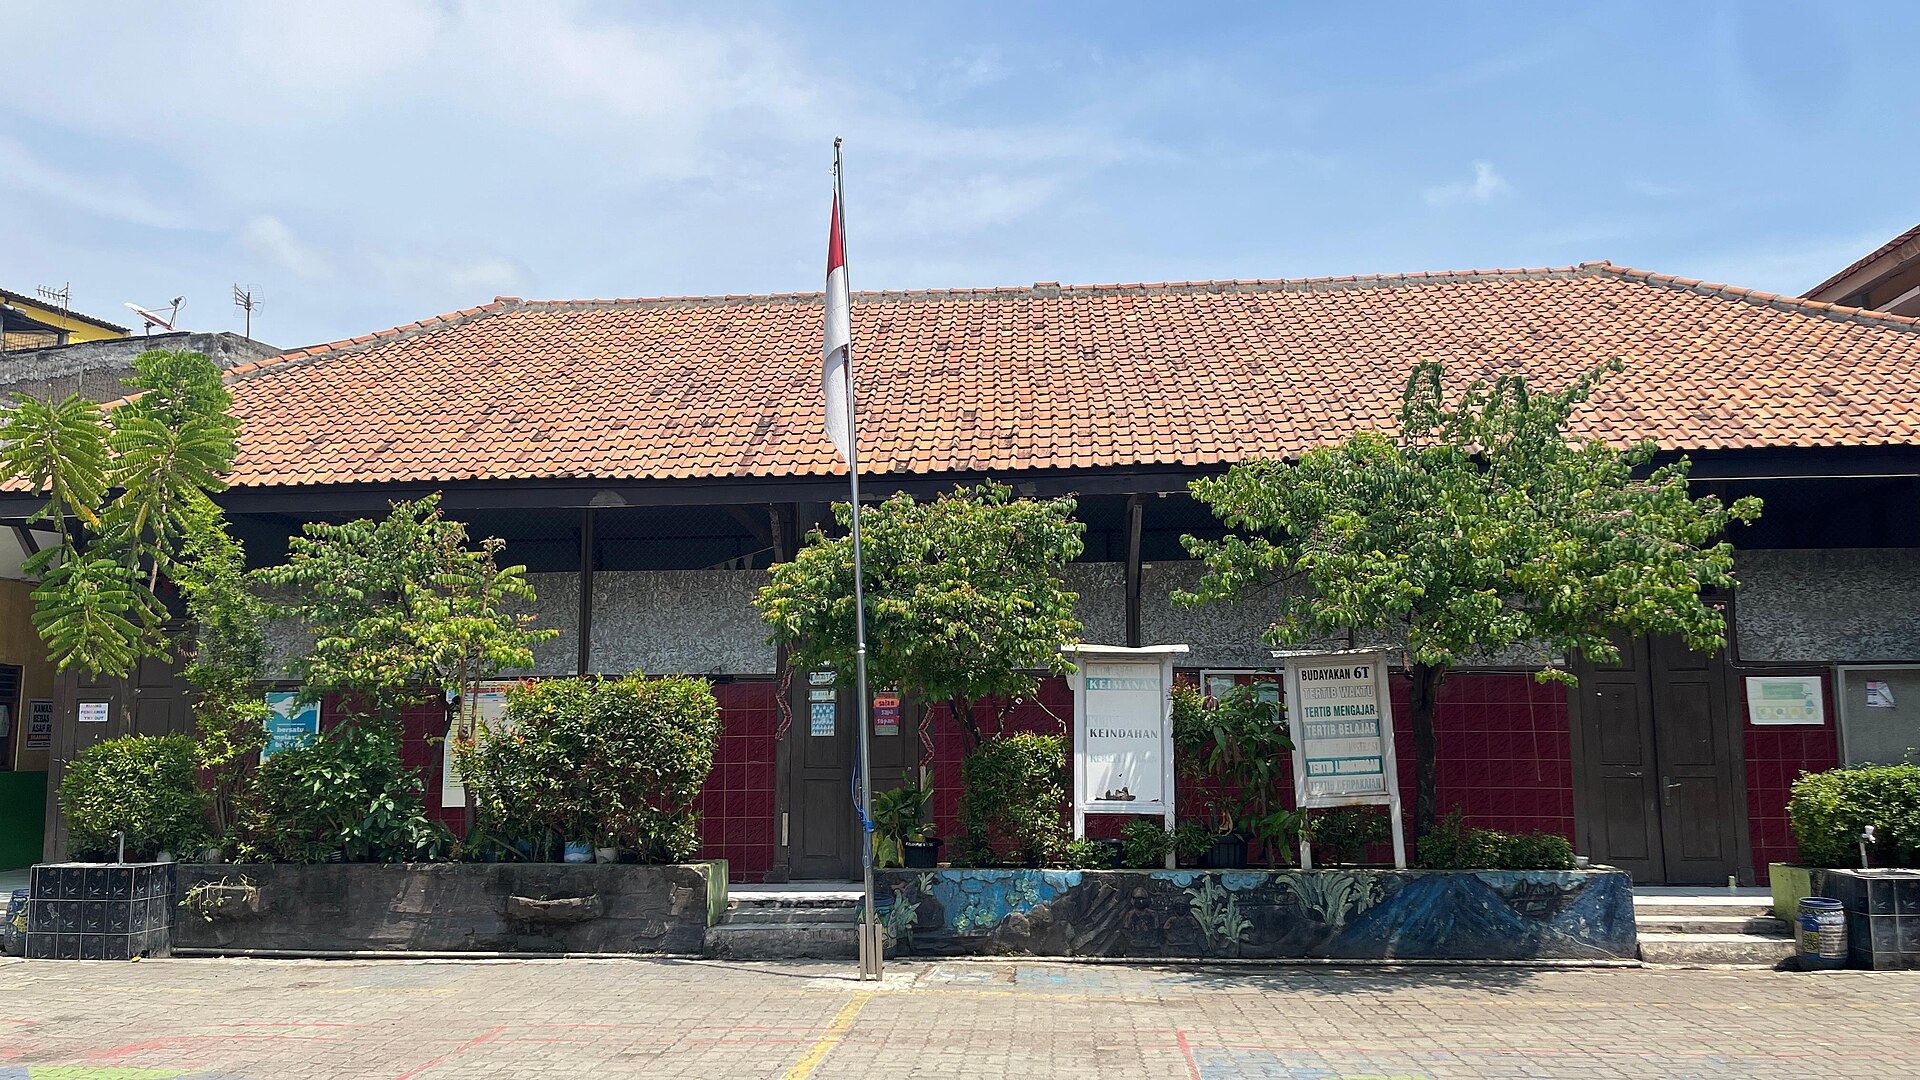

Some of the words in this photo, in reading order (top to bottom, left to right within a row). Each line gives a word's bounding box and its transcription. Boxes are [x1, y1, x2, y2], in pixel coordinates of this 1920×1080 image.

[1301, 668, 1351, 681] BUDAYAKAN
[1353, 666, 1370, 679] 6T
[1303, 686, 1338, 699] TERTIB
[1339, 685, 1374, 698] WAKTU
[1304, 706, 1331, 718] TERTIB
[1333, 704, 1376, 717] MENGAJAR
[1089, 728, 1158, 739] KEINDAHAN
[1306, 724, 1336, 737] TERTIB
[1338, 722, 1377, 736] BELAJAR
